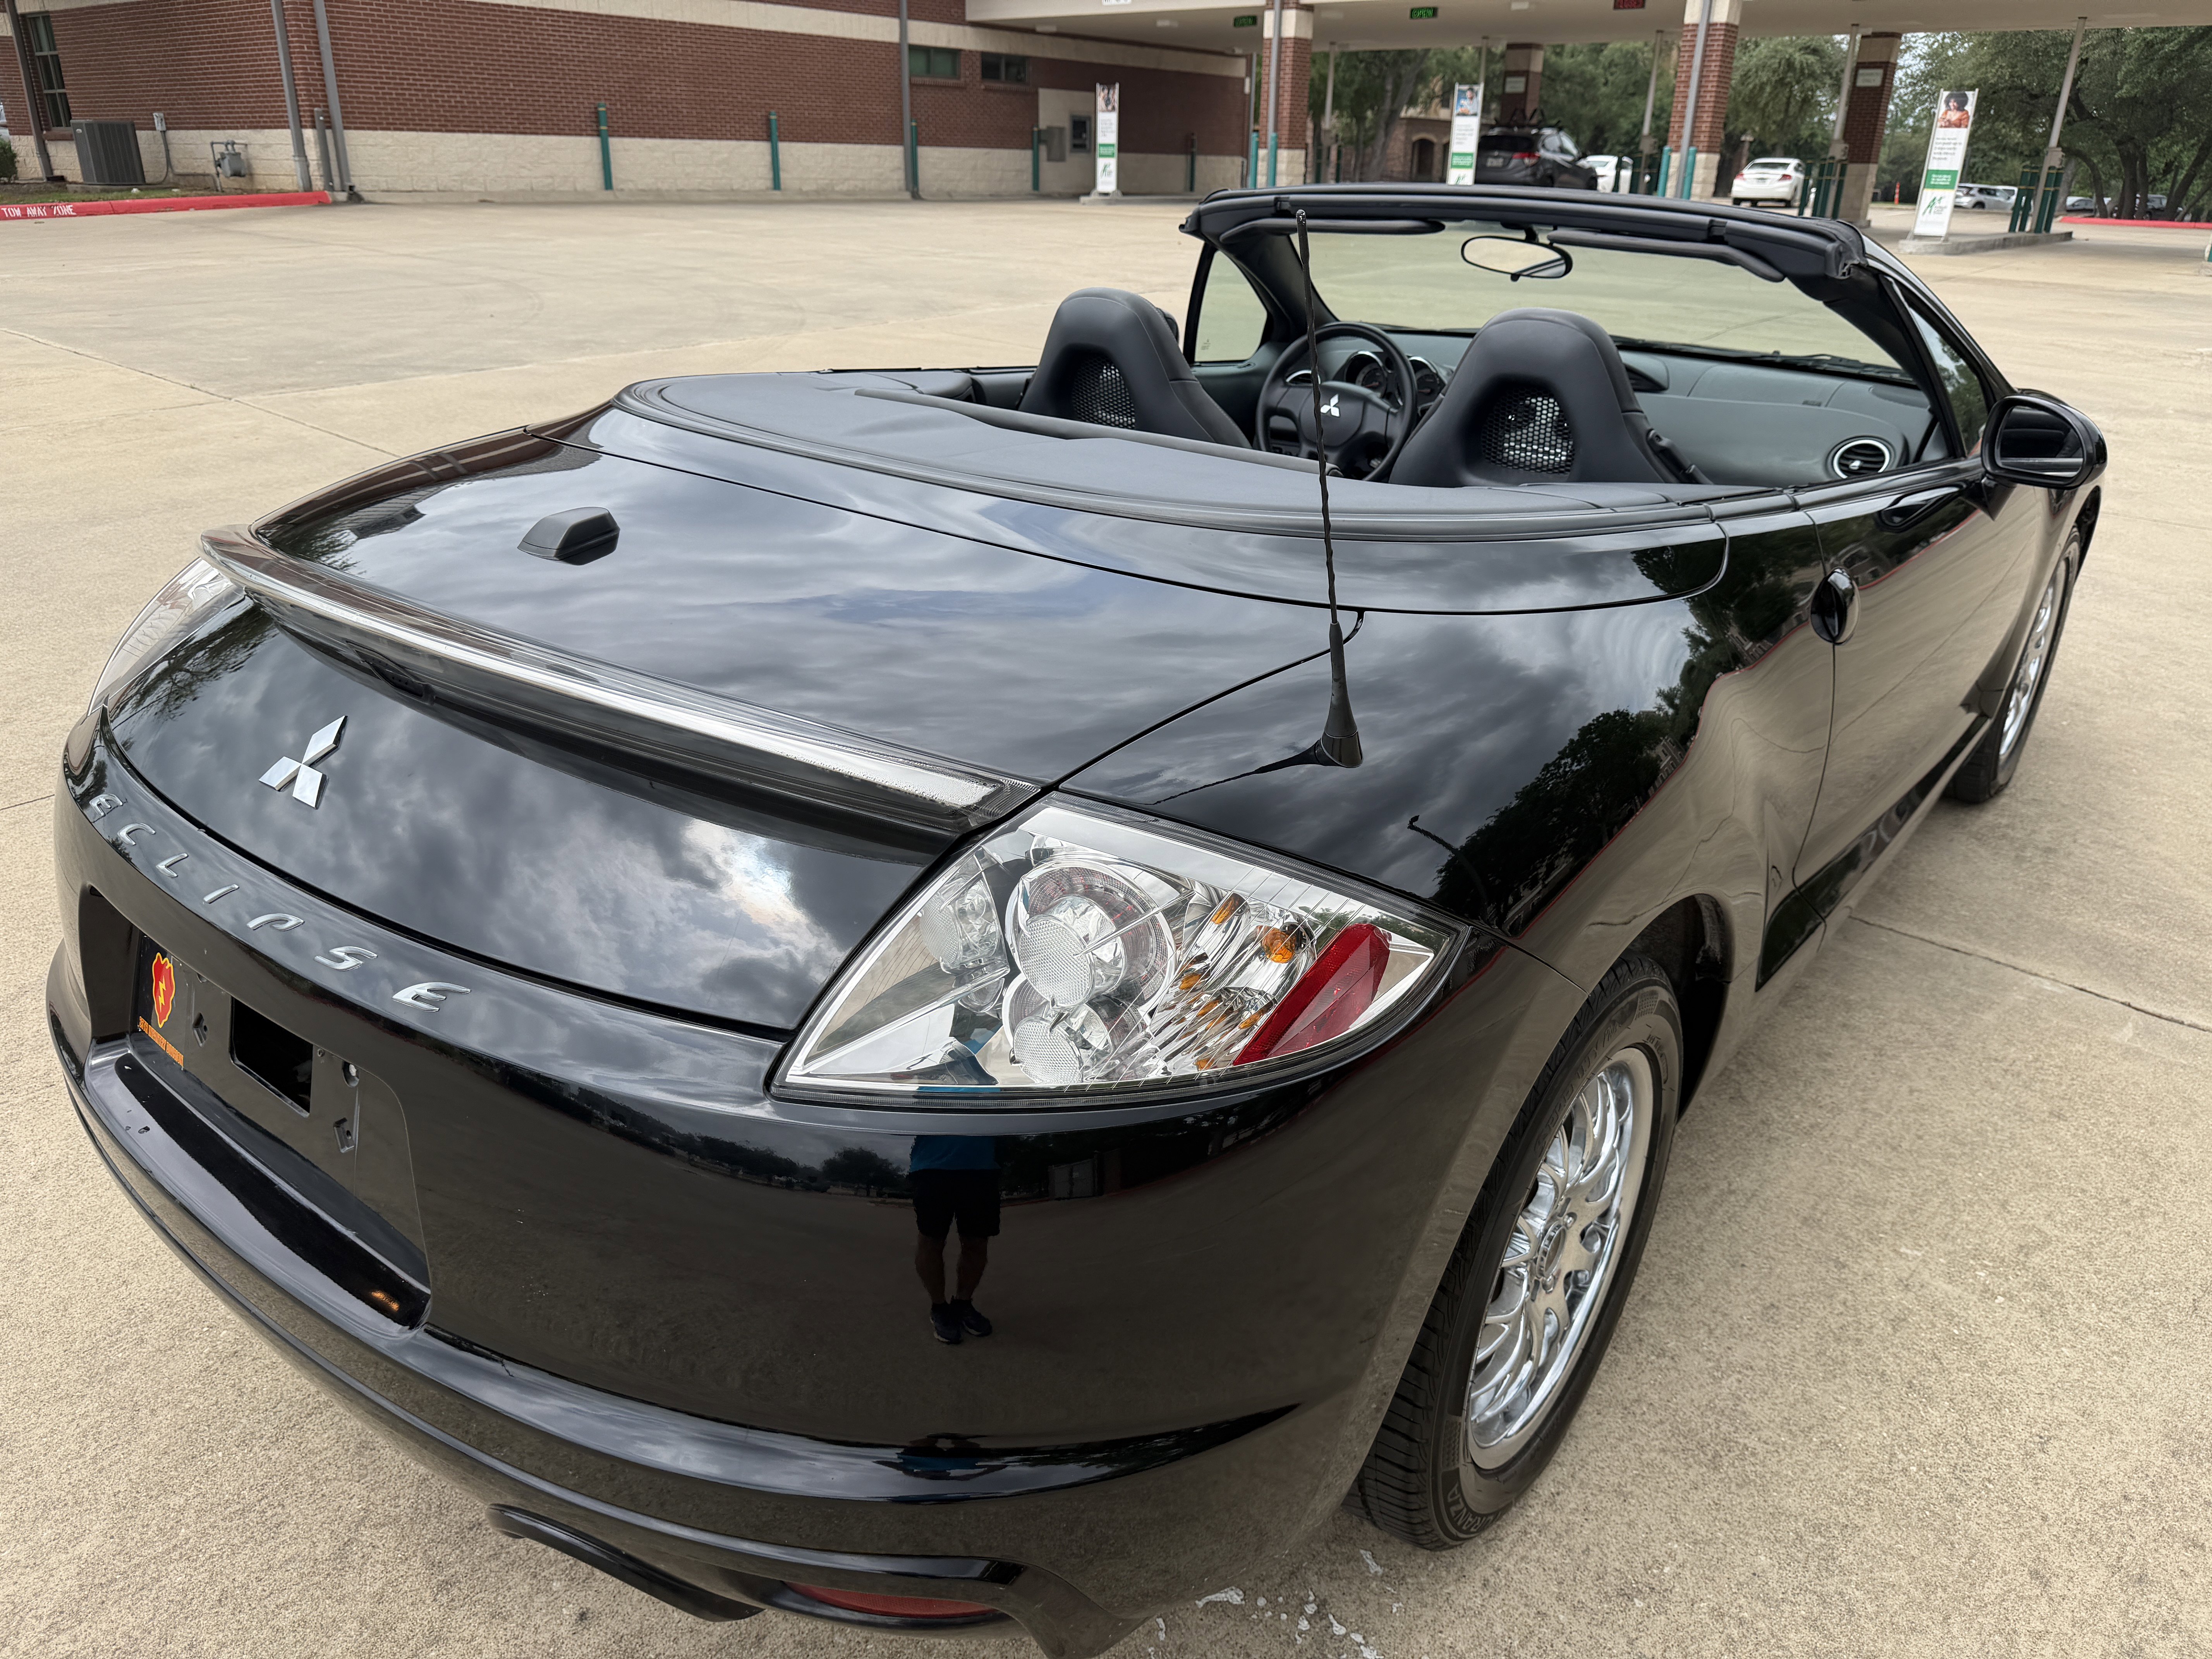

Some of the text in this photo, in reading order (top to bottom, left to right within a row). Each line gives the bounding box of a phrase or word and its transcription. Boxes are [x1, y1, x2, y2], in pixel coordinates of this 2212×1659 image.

[1, 205, 77, 217] TOW AWAY ZONE
[89, 793, 471, 1012] ECLIPSE
